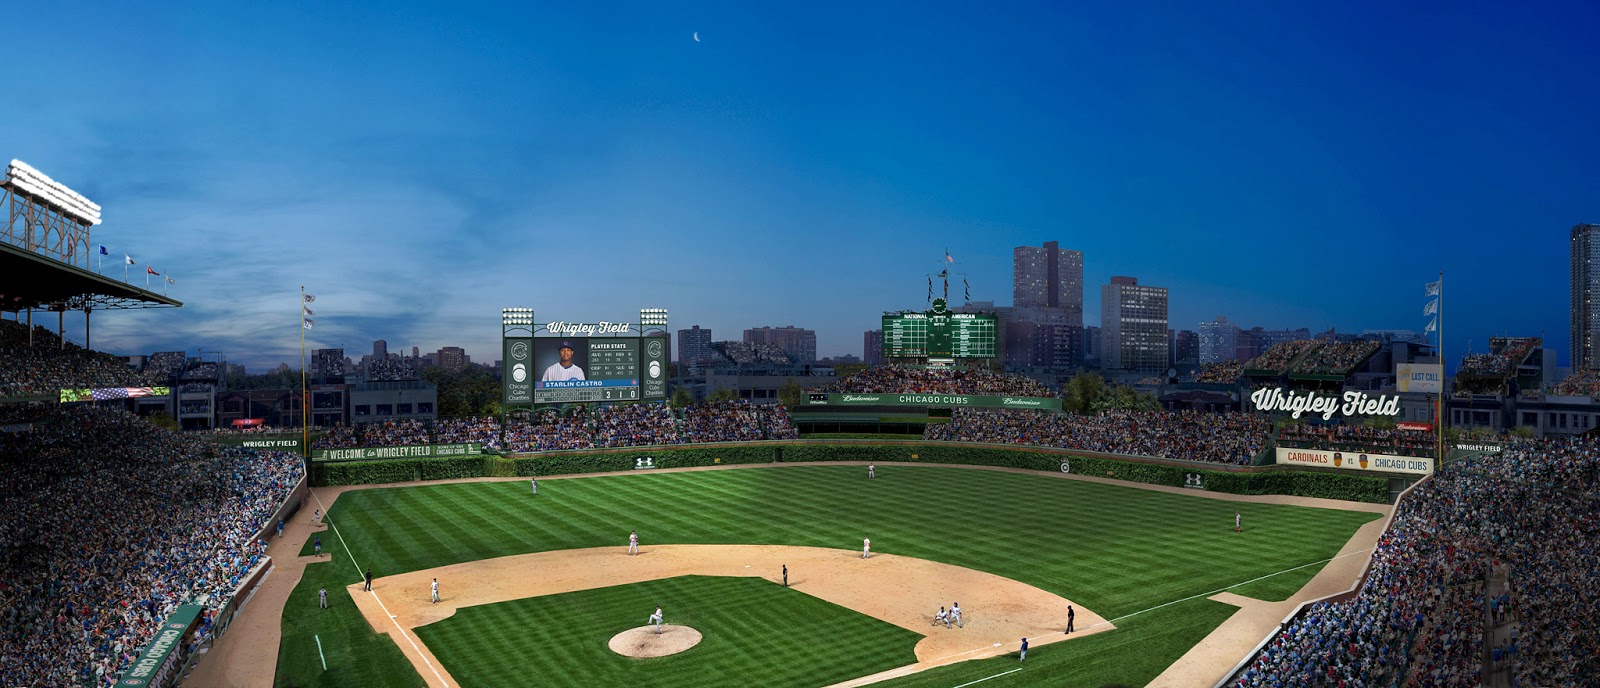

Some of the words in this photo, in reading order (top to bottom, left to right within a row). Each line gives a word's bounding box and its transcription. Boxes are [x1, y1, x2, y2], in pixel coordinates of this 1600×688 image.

[546, 321, 596, 337] Wrigley
[598, 321, 630, 334] Field
[1411, 372, 1425, 381] LAST
[1425, 372, 1440, 382] CALL
[606, 391, 611, 399] 3
[630, 390, 636, 398] 0
[899, 395, 940, 403] CHICAGO
[943, 396, 968, 404] CUBS
[1002, 397, 1041, 406] Budweiser
[1251, 387, 1339, 421] Wrigley
[1342, 390, 1399, 417] Field
[242, 440, 276, 448] WRIGLEY
[1456, 443, 1483, 451] WRIGLEY
[330, 448, 366, 460] WELCOME
[376, 446, 409, 458] WRIGLEY
[410, 446, 430, 456] FIELD
[1287, 451, 1328, 464] CARDINALS
[1374, 457, 1406, 469] CHICAGO
[1408, 459, 1427, 471] CUBS
[146, 629, 180, 658] CHICAGO
[130, 658, 158, 678] CUBS
